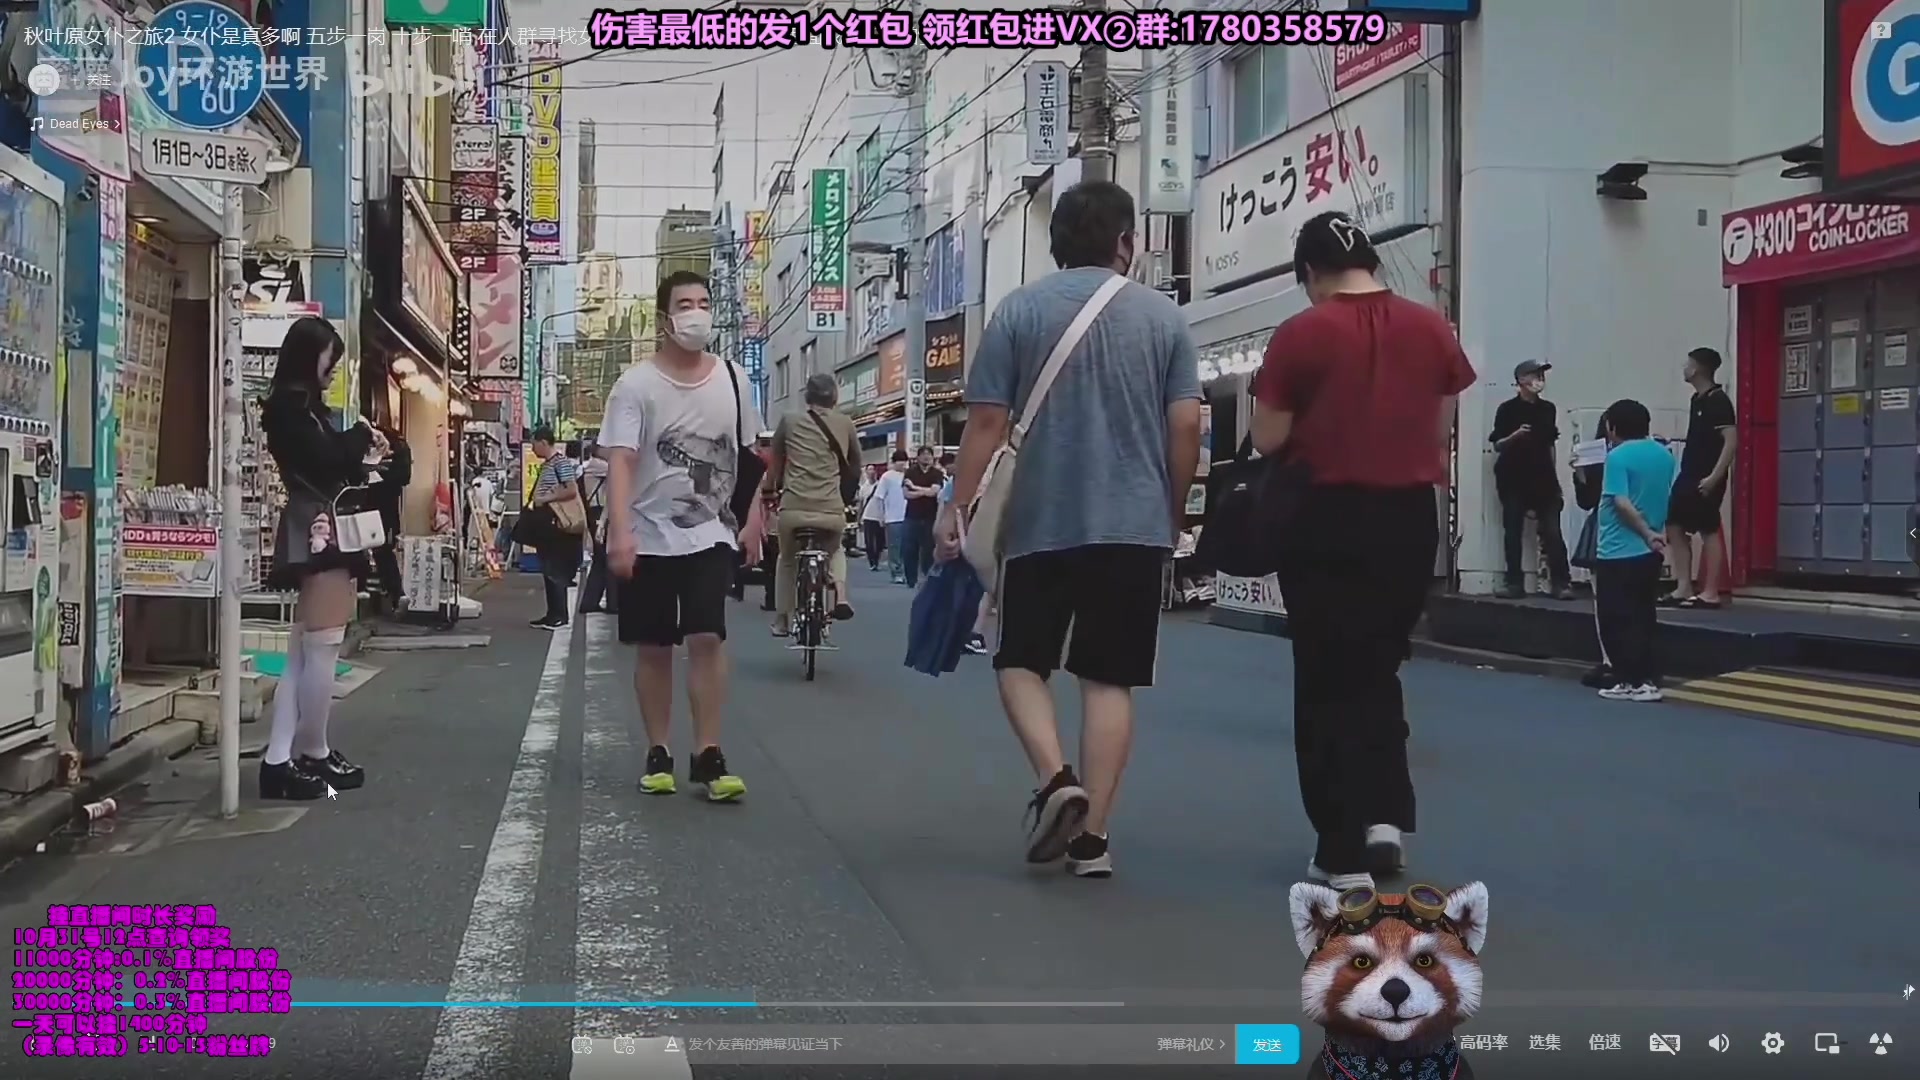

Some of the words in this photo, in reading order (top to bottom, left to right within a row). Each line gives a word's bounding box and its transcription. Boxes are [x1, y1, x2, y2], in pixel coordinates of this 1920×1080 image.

[175, 8, 229, 29] 9-19
[166, 35, 214, 112] P
[201, 79, 236, 115] 60
[1219, 124, 1379, 234] けっこう安い。
[461, 207, 487, 219] 2F
[1754, 207, 1796, 258] ¥300
[460, 256, 487, 268] 2F
[816, 312, 835, 327] B1
